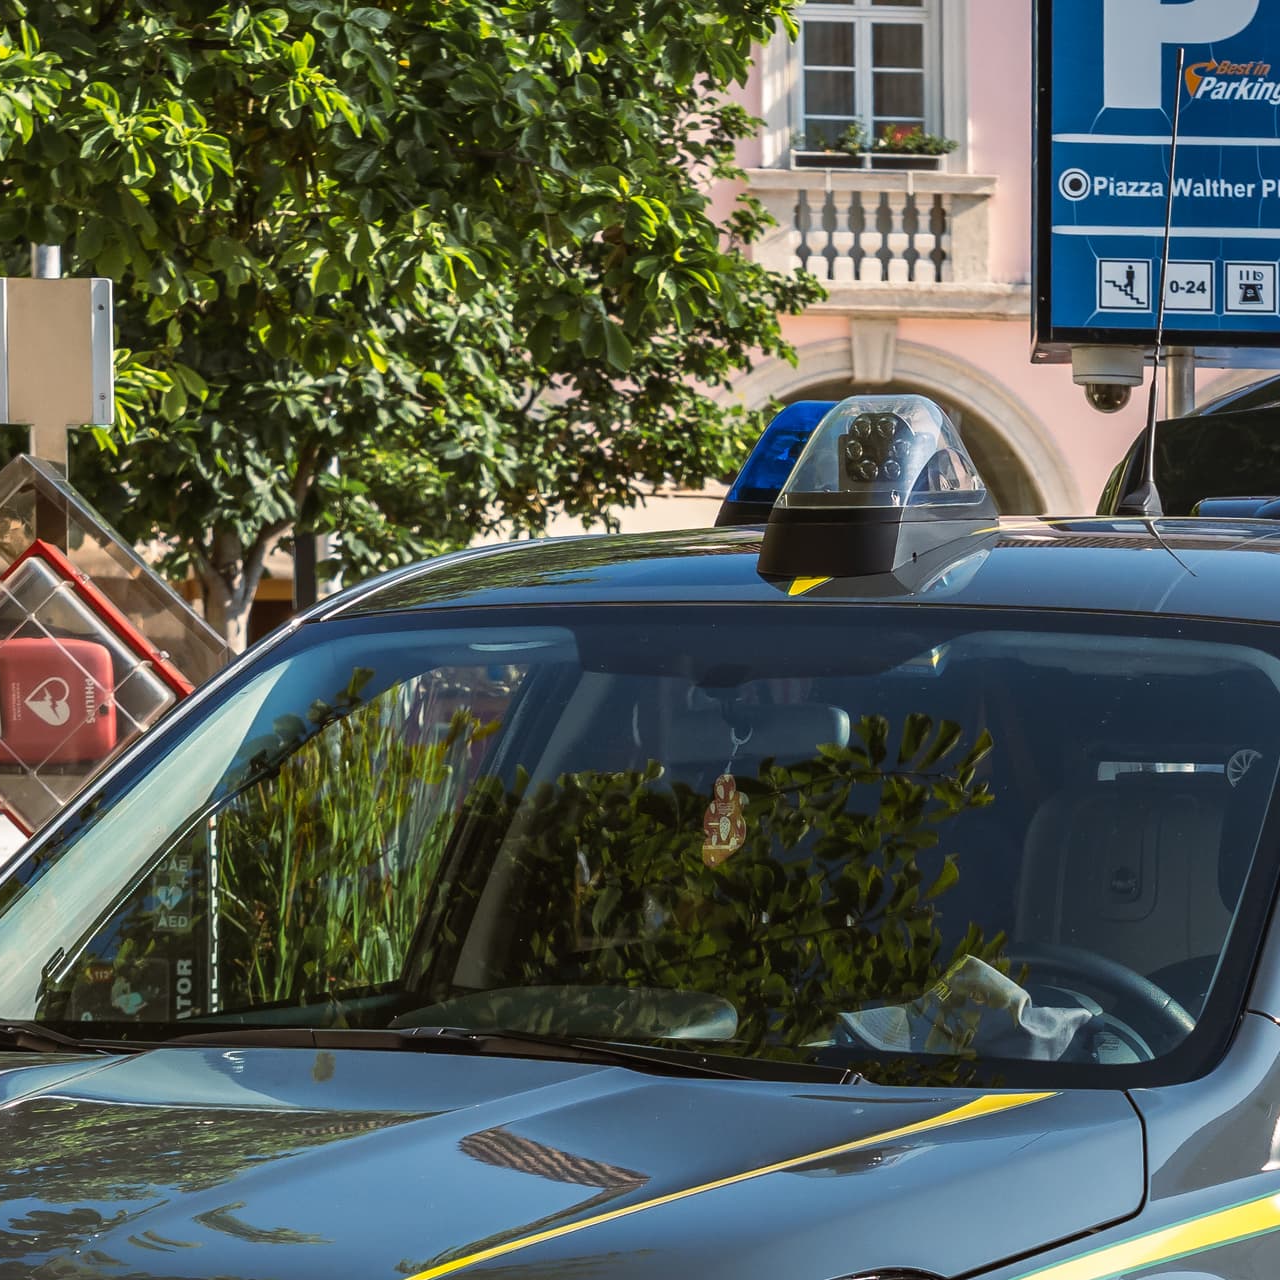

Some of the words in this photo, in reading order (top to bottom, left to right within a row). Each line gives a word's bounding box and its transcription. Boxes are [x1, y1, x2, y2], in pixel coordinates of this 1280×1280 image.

[1216, 59, 1251, 76] Best
[1254, 61, 1272, 76] in
[1093, 176, 1164, 198] Piazza
[1171, 177, 1254, 199] Walther
[1170, 280, 1207, 295] 0-24
[85, 678, 96, 724] PHILIPS
[158, 914, 189, 928] AED
